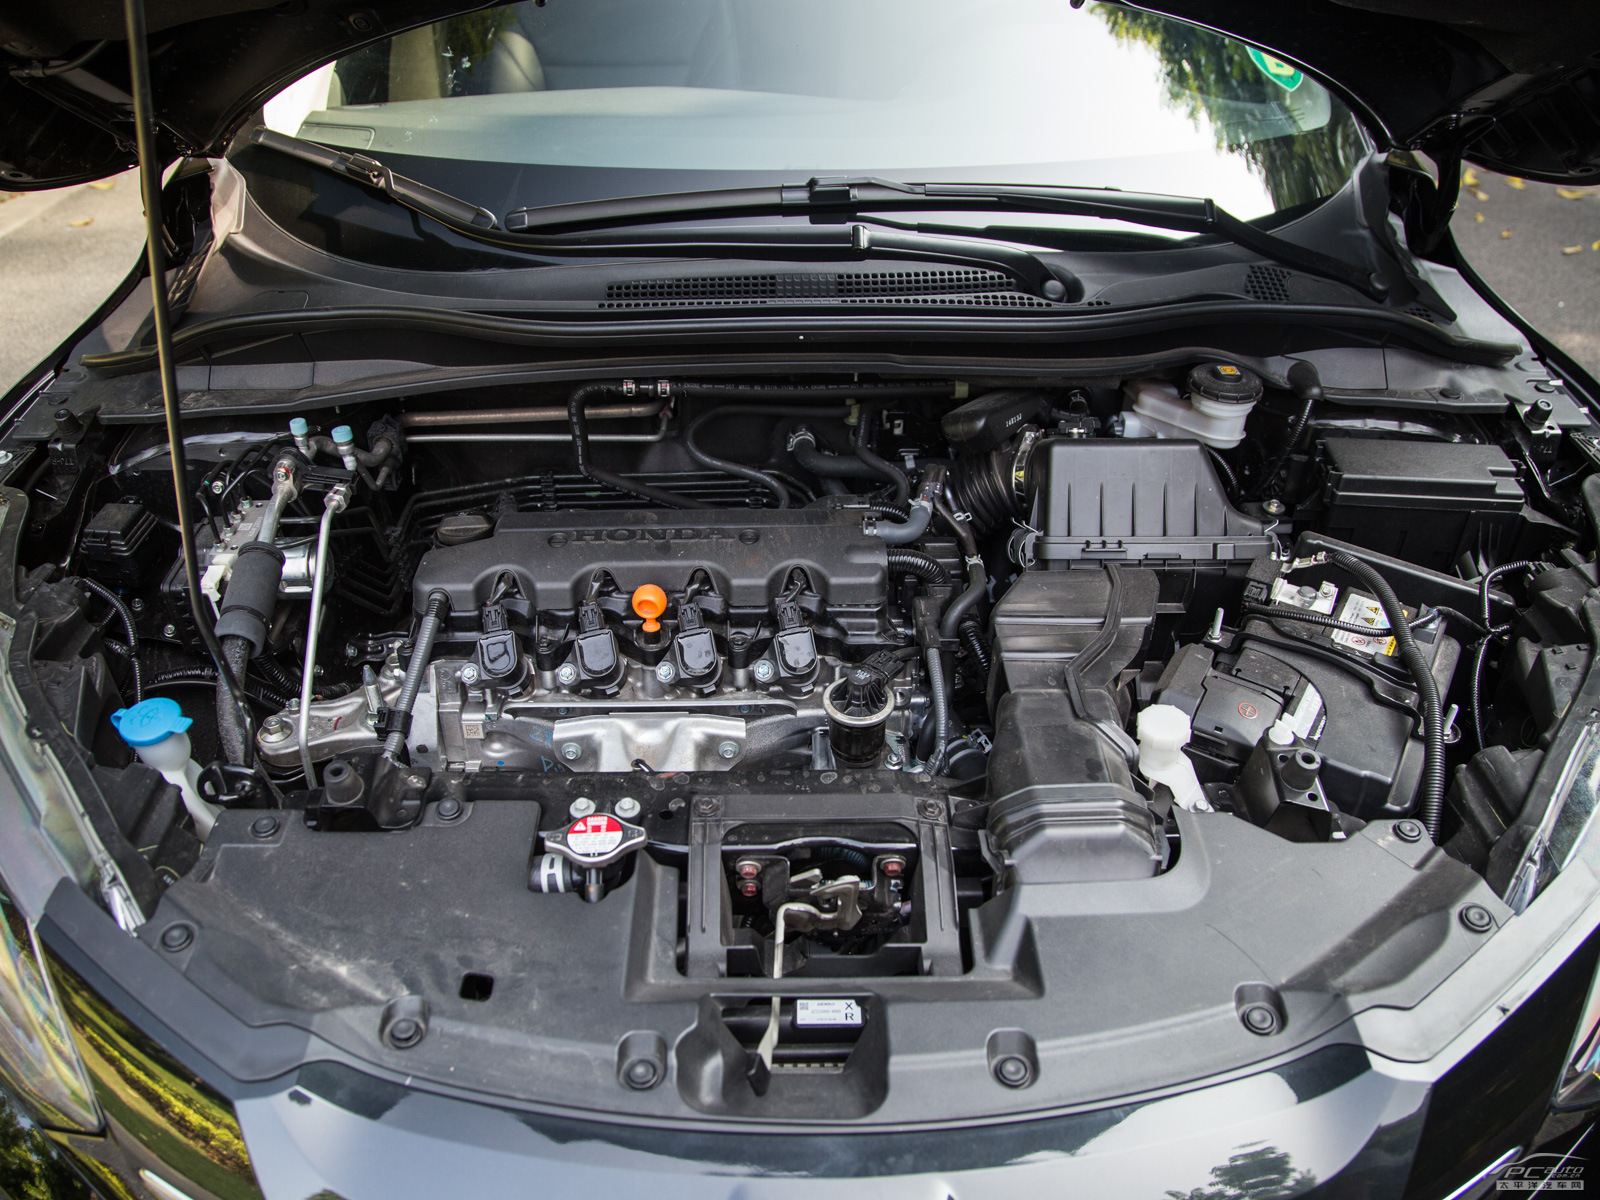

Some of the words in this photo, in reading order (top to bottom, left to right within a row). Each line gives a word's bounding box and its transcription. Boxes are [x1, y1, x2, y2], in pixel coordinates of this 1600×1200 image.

[571, 527, 736, 545] HONDA
[845, 1001, 854, 1010] X
[845, 1012, 854, 1021] R
